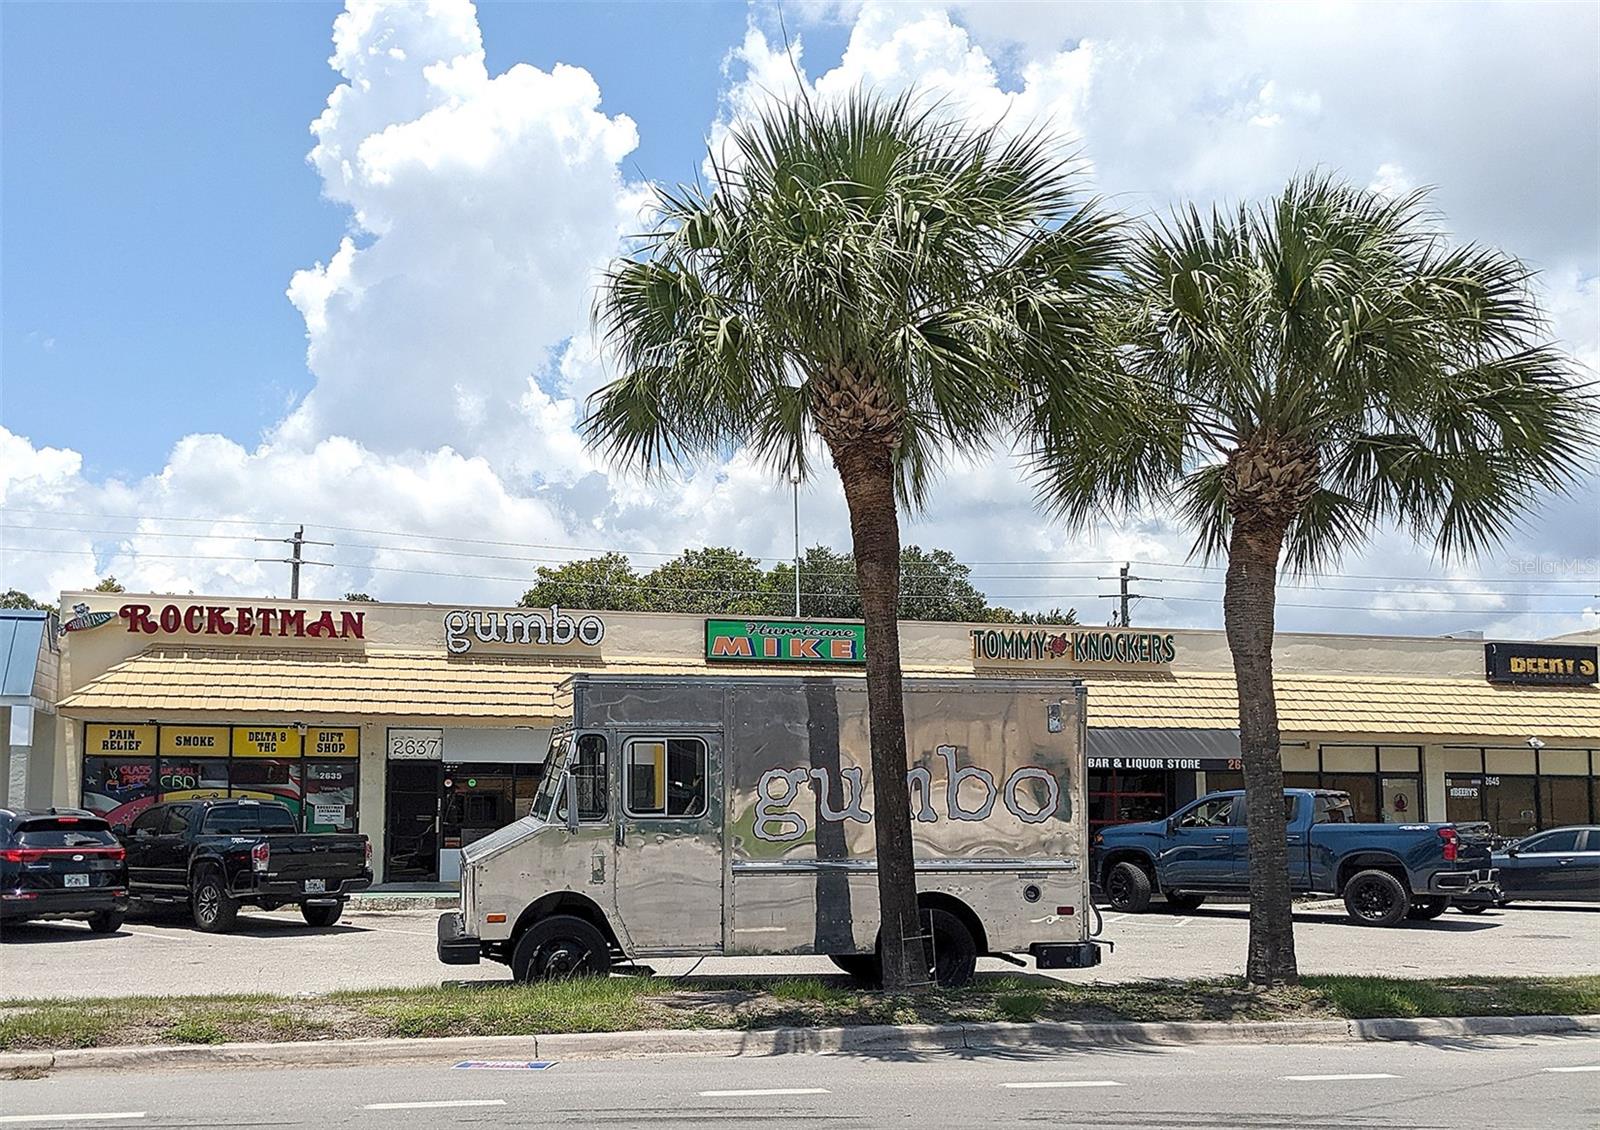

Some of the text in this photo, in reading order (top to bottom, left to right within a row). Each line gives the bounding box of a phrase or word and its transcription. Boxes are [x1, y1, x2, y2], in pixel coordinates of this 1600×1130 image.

[118, 604, 366, 639] ROCKETMAN
[444, 604, 605, 654] gumbo
[745, 622, 857, 638] Hurricane
[711, 636, 867, 660] MIKE
[970, 629, 1177, 664] TOMMY KNOCKERS
[109, 729, 136, 740] PAIN
[248, 731, 287, 742] DELTA 8
[318, 732, 344, 742] GIFT
[102, 740, 142, 751] RELIEF
[175, 735, 215, 747] SMOKE
[393, 739, 438, 755] 2637
[257, 742, 277, 753] THC
[316, 742, 346, 753] SHOP
[1087, 758, 1201, 770] BAR & LIQUOR STORE
[1227, 759, 1246, 771] 26
[160, 774, 196, 789] CBD
[319, 772, 342, 780] 2635
